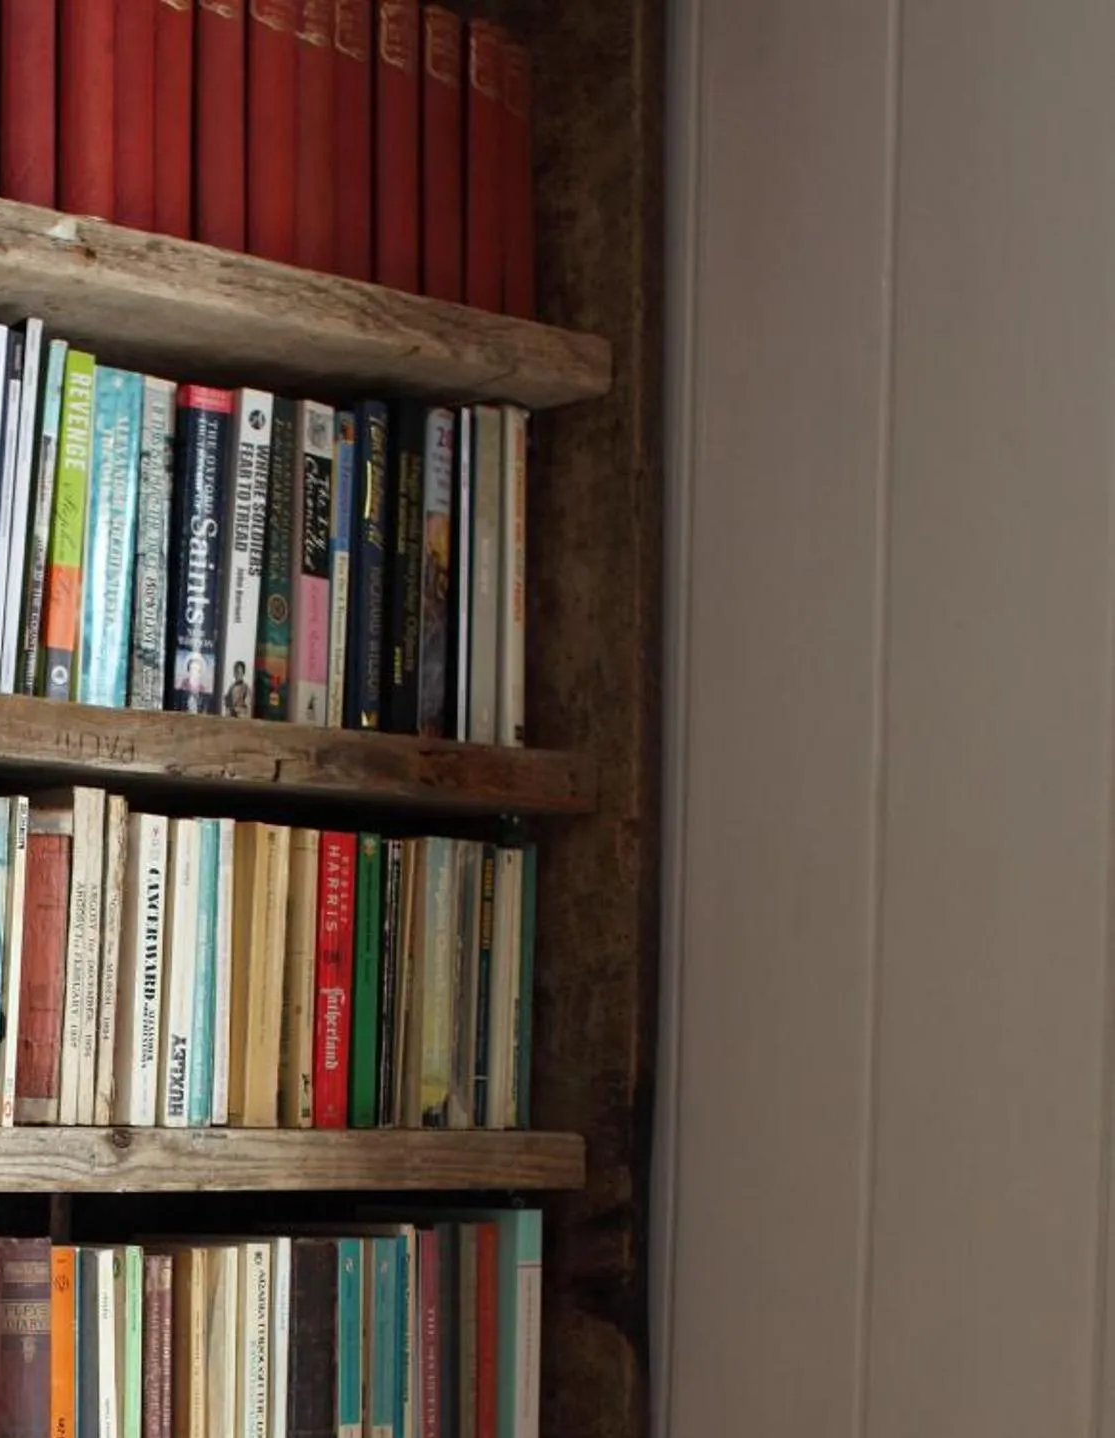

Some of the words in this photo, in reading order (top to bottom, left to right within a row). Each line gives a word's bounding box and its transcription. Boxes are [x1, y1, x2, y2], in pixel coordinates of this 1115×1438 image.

[65, 372, 93, 472] REVENGE
[206, 419, 219, 451] THE
[204, 455, 217, 515] OXFORD
[236, 482, 251, 500] TO
[237, 441, 253, 479] FEAR
[251, 444, 270, 496] WHERE
[317, 474, 328, 504] The
[233, 504, 250, 552] TREAD
[247, 499, 266, 577] SOLDIERS
[302, 456, 319, 571] Chronicles
[186, 516, 218, 625] Saints
[145, 868, 160, 940] CANCER
[324, 844, 340, 932] HARRIS
[338, 855, 350, 924] ROBERT
[142, 944, 156, 1001] WARD
[316, 987, 345, 1070] Fatherland
[166, 1034, 187, 1117] HUXLEY
[57, 1417, 66, 1432] Jim
